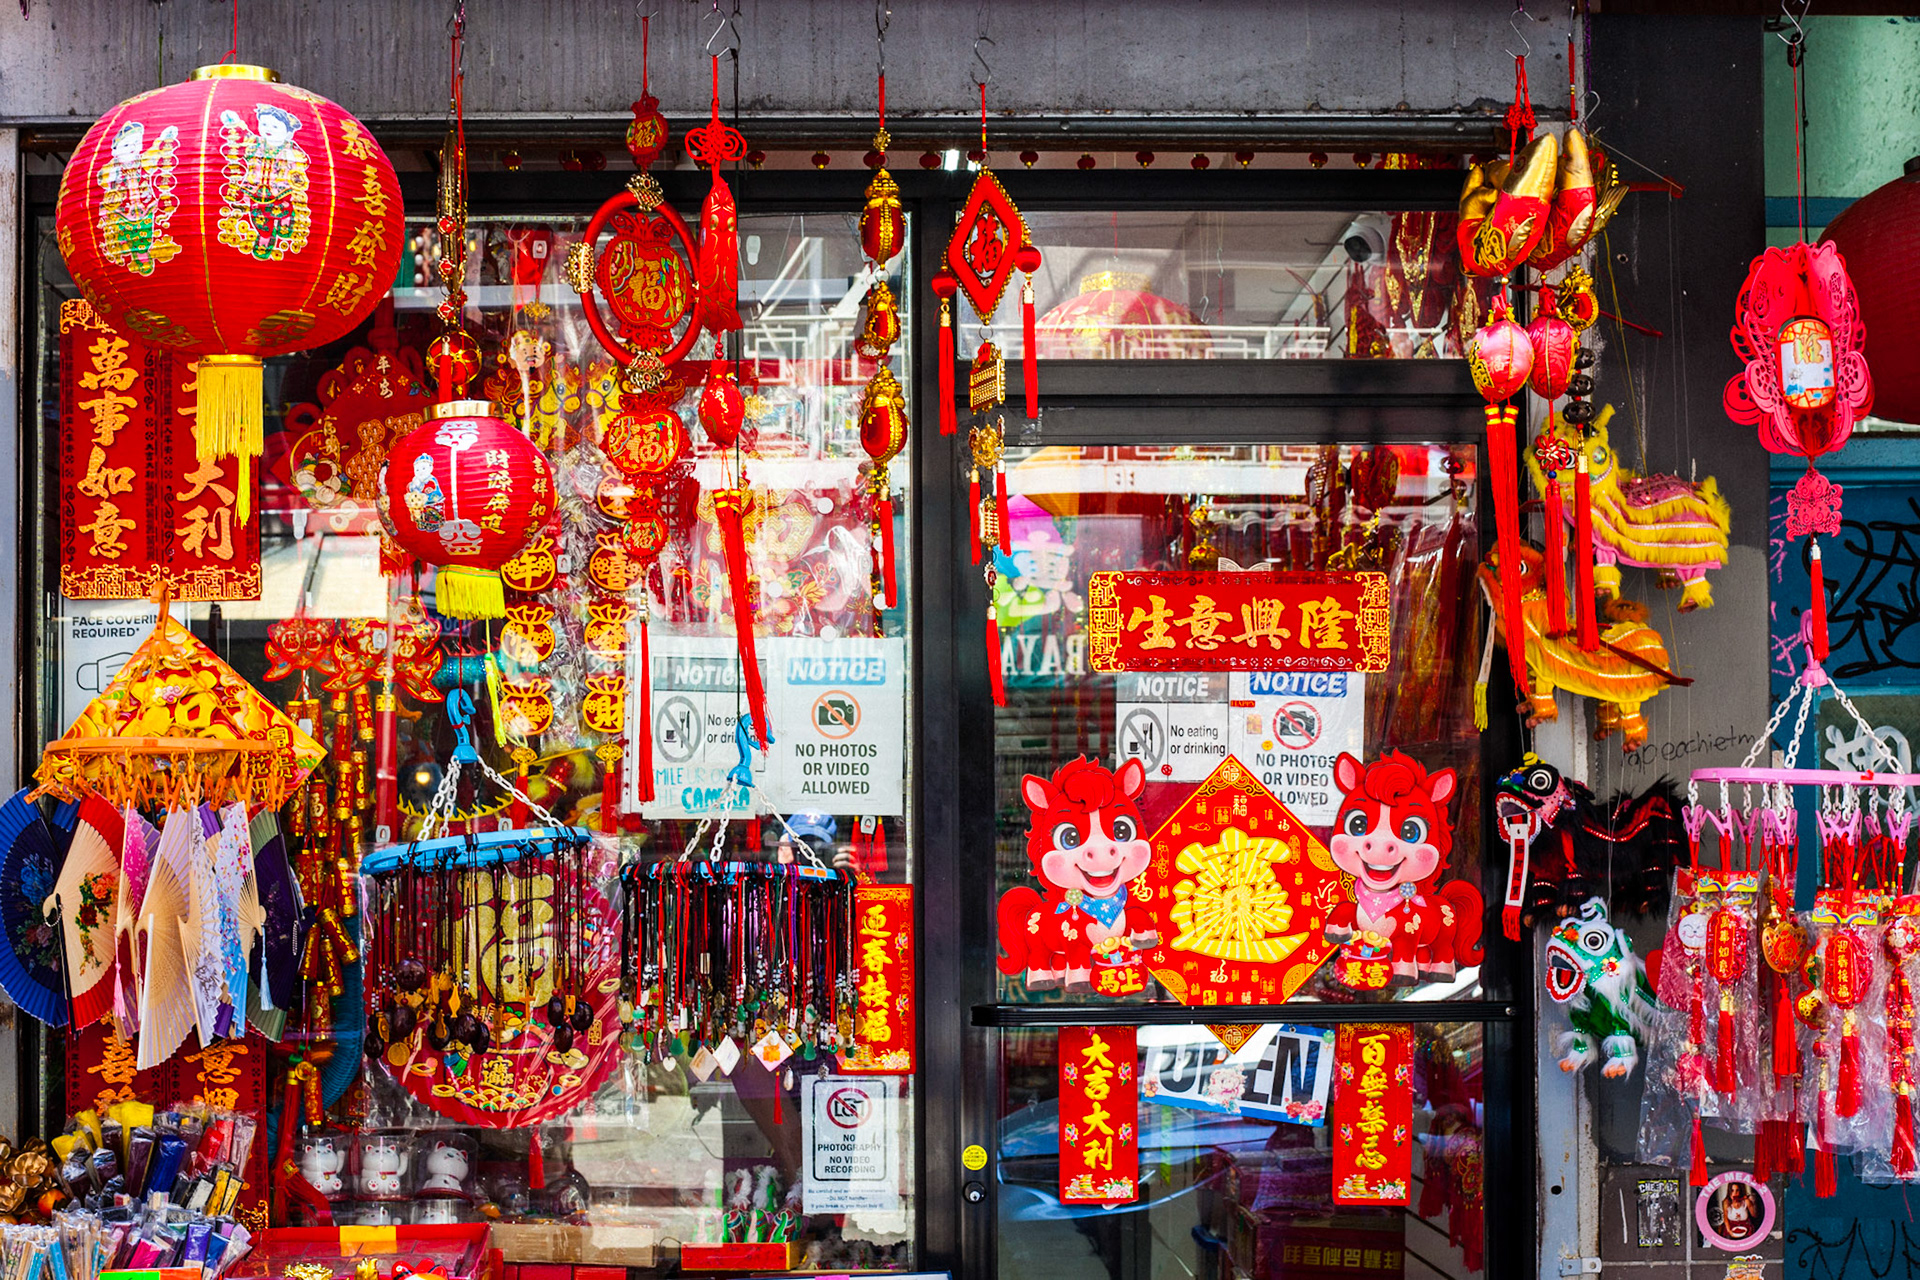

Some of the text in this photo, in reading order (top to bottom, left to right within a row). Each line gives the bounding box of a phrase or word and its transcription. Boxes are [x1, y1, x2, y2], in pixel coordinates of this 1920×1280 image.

[629, 257, 667, 310] 福
[77, 336, 140, 560] 萬事如意
[626, 423, 663, 463] 福
[72, 616, 102, 626] FACE
[1127, 595, 1354, 650] 生意興隆
[791, 660, 882, 682] NOTICE
[1136, 677, 1210, 697] NOTICE
[1252, 672, 1345, 694] NOTICE
[707, 714, 722, 726] No
[707, 734, 718, 743] or
[1170, 725, 1219, 740] No eating
[795, 744, 877, 757] NO PHOTOS
[1170, 743, 1226, 757] or drinking
[803, 762, 869, 776] OR VIDEO
[1256, 754, 1335, 769] NO PHOTOS
[653, 767, 684, 786] MILE
[1263, 772, 1328, 787] OR VIDEO
[801, 781, 870, 795] ALLOWED
[859, 904, 893, 1043] 迎春接福
[1097, 968, 1143, 993] 馬上
[1081, 1033, 1115, 1171] 大吉大利
[1355, 1033, 1390, 1171] 百無禁忌
[843, 1134, 855, 1142] NO
[830, 1156, 870, 1164] NO VIDEO
[1700, 1179, 1721, 1199] THE
